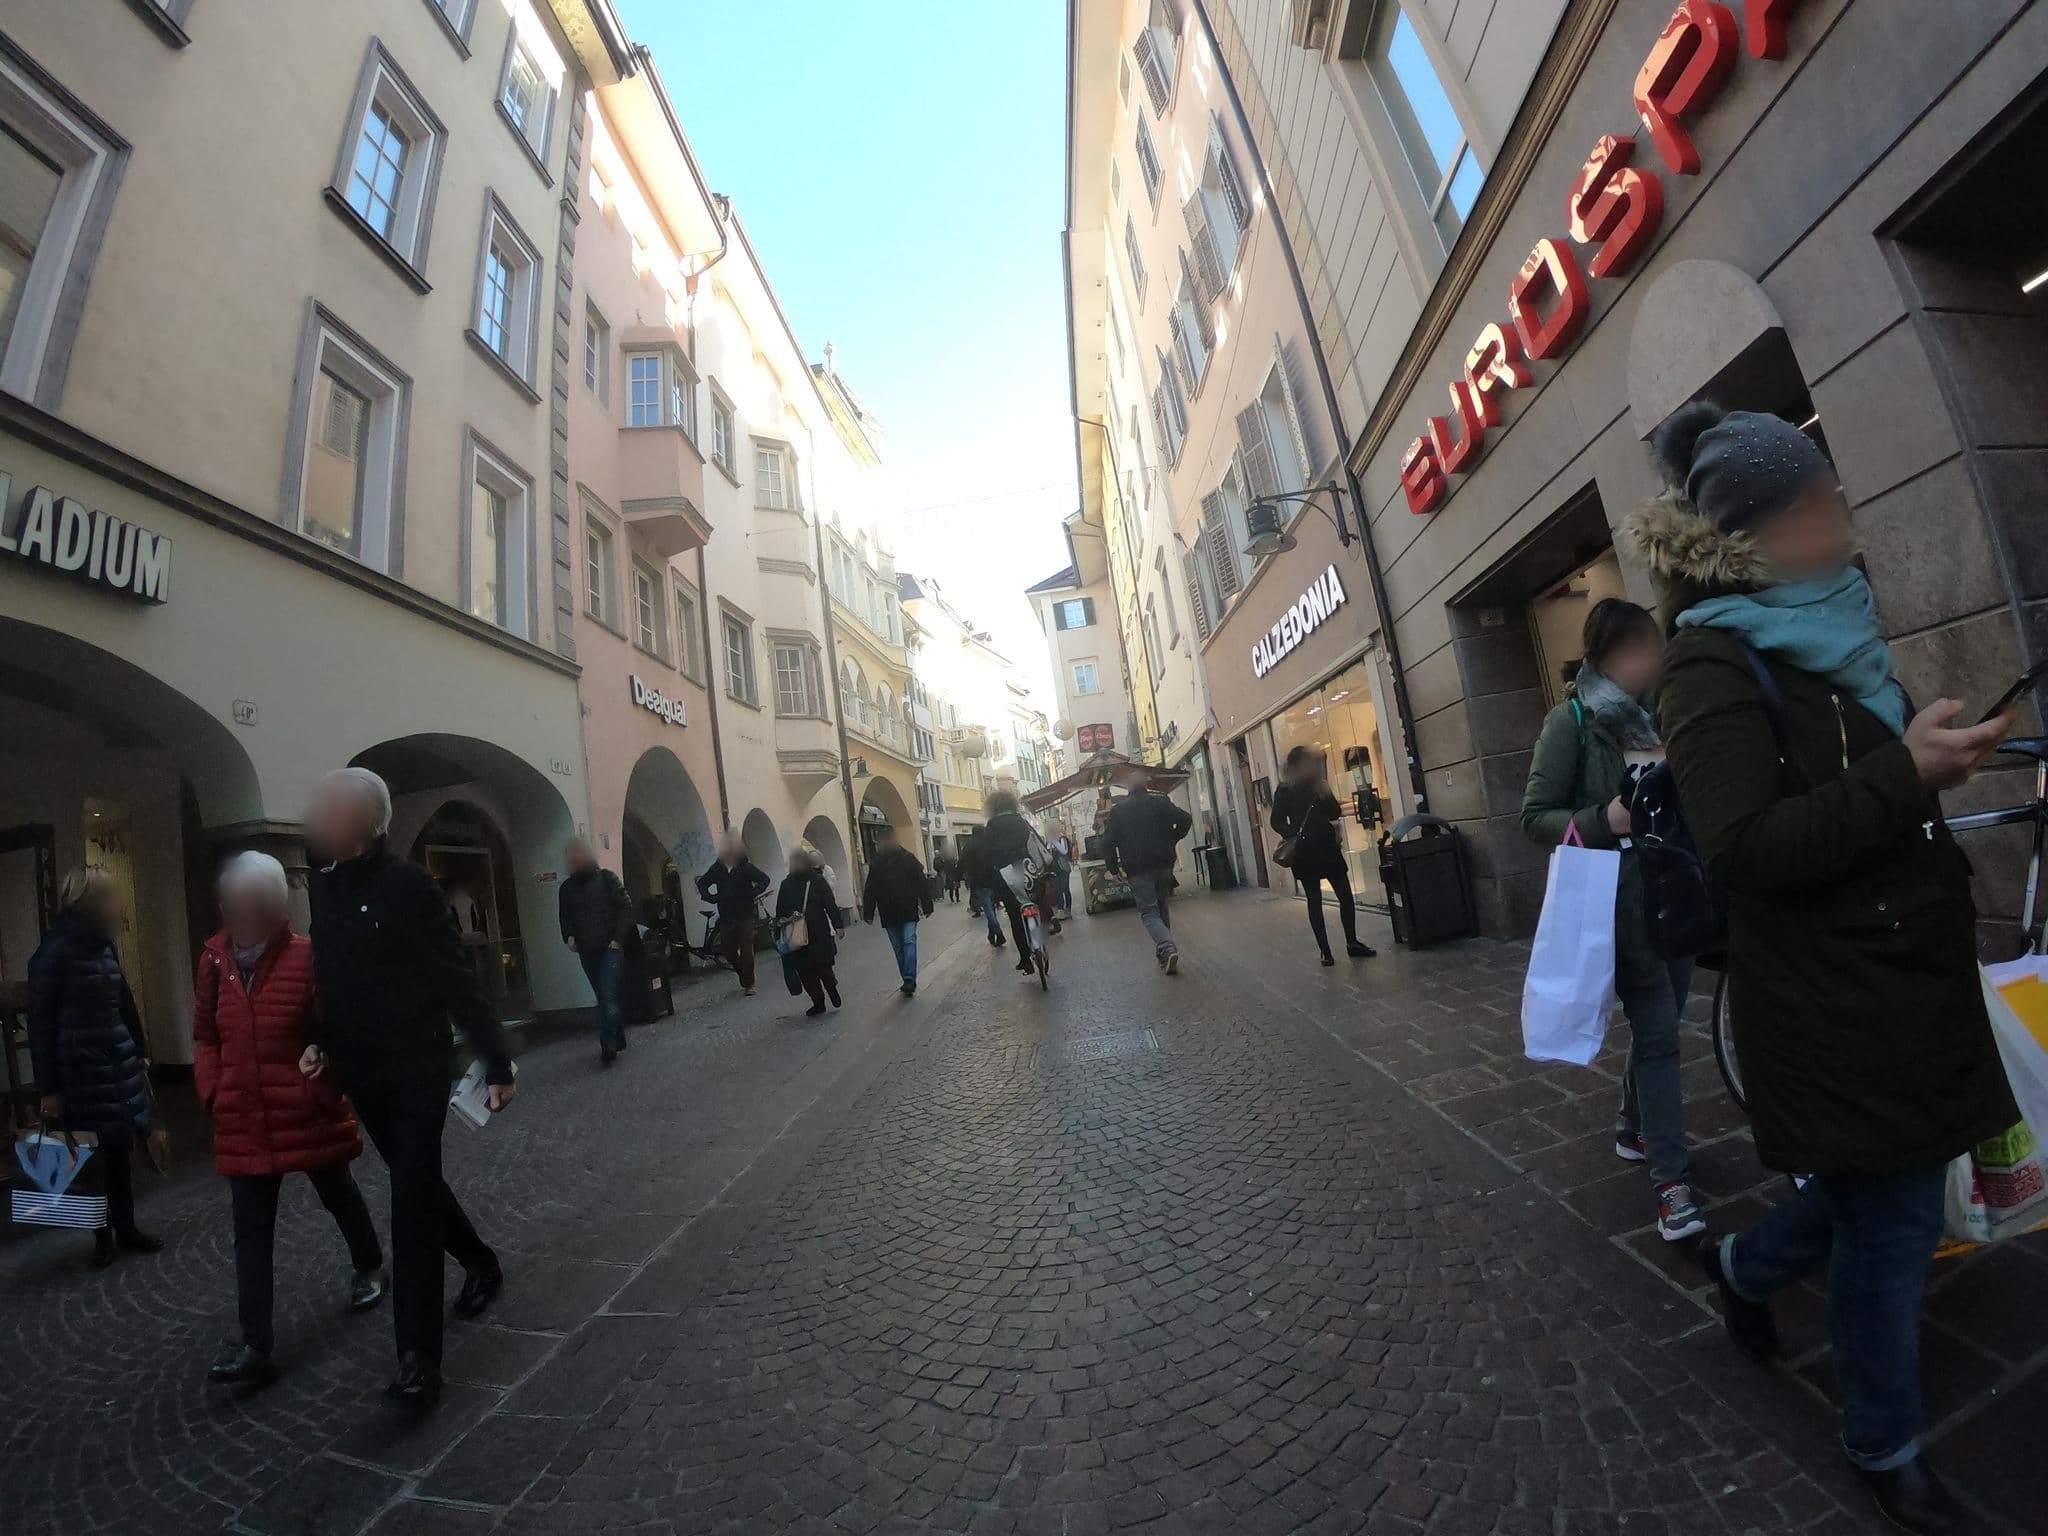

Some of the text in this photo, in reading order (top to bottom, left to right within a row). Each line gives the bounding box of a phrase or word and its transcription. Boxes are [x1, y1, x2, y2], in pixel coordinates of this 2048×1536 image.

[0, 470, 173, 604] LADIUM
[1252, 563, 1347, 679] CALZEDONIA
[630, 674, 689, 728] Desigual
